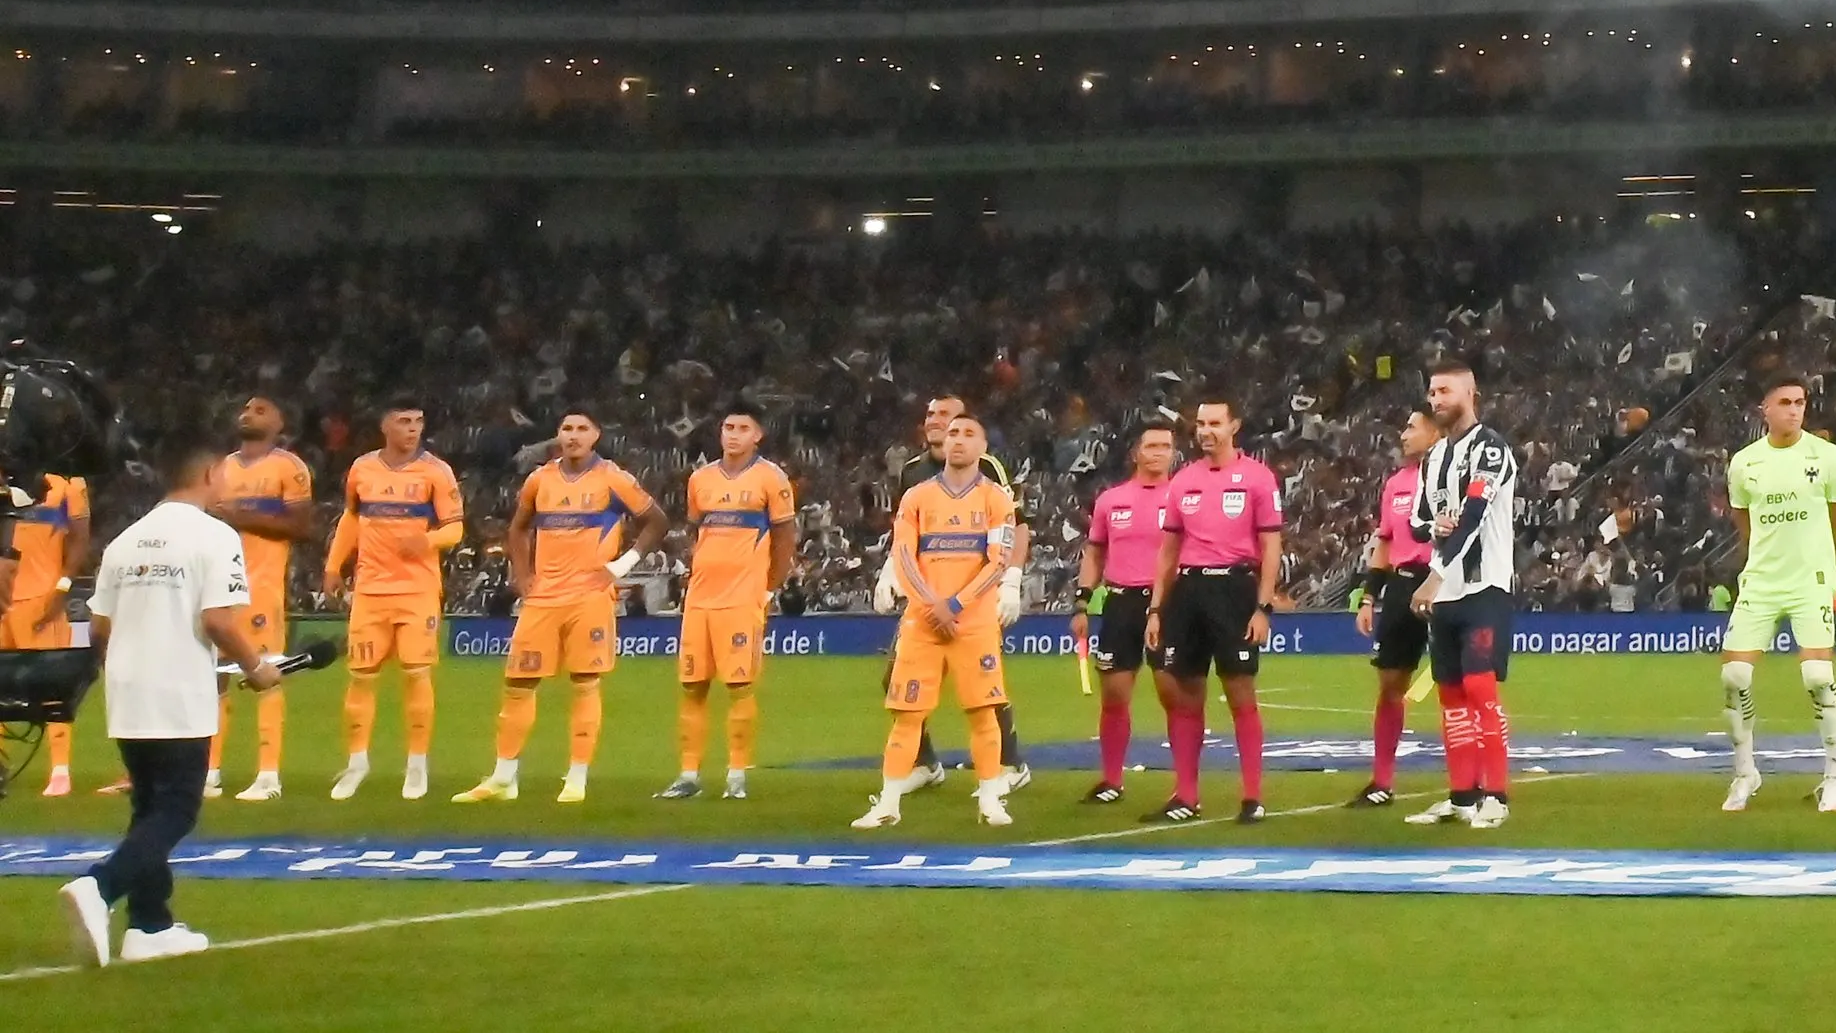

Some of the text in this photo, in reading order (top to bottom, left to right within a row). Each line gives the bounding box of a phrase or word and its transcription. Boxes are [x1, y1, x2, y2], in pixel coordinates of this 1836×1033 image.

[1766, 491, 1798, 505] BBVA
[1759, 509, 1808, 525] codere
[782, 629, 810, 655] de
[1023, 635, 1052, 654] no
[1512, 632, 1544, 652] no
[1551, 632, 1622, 654] pagar
